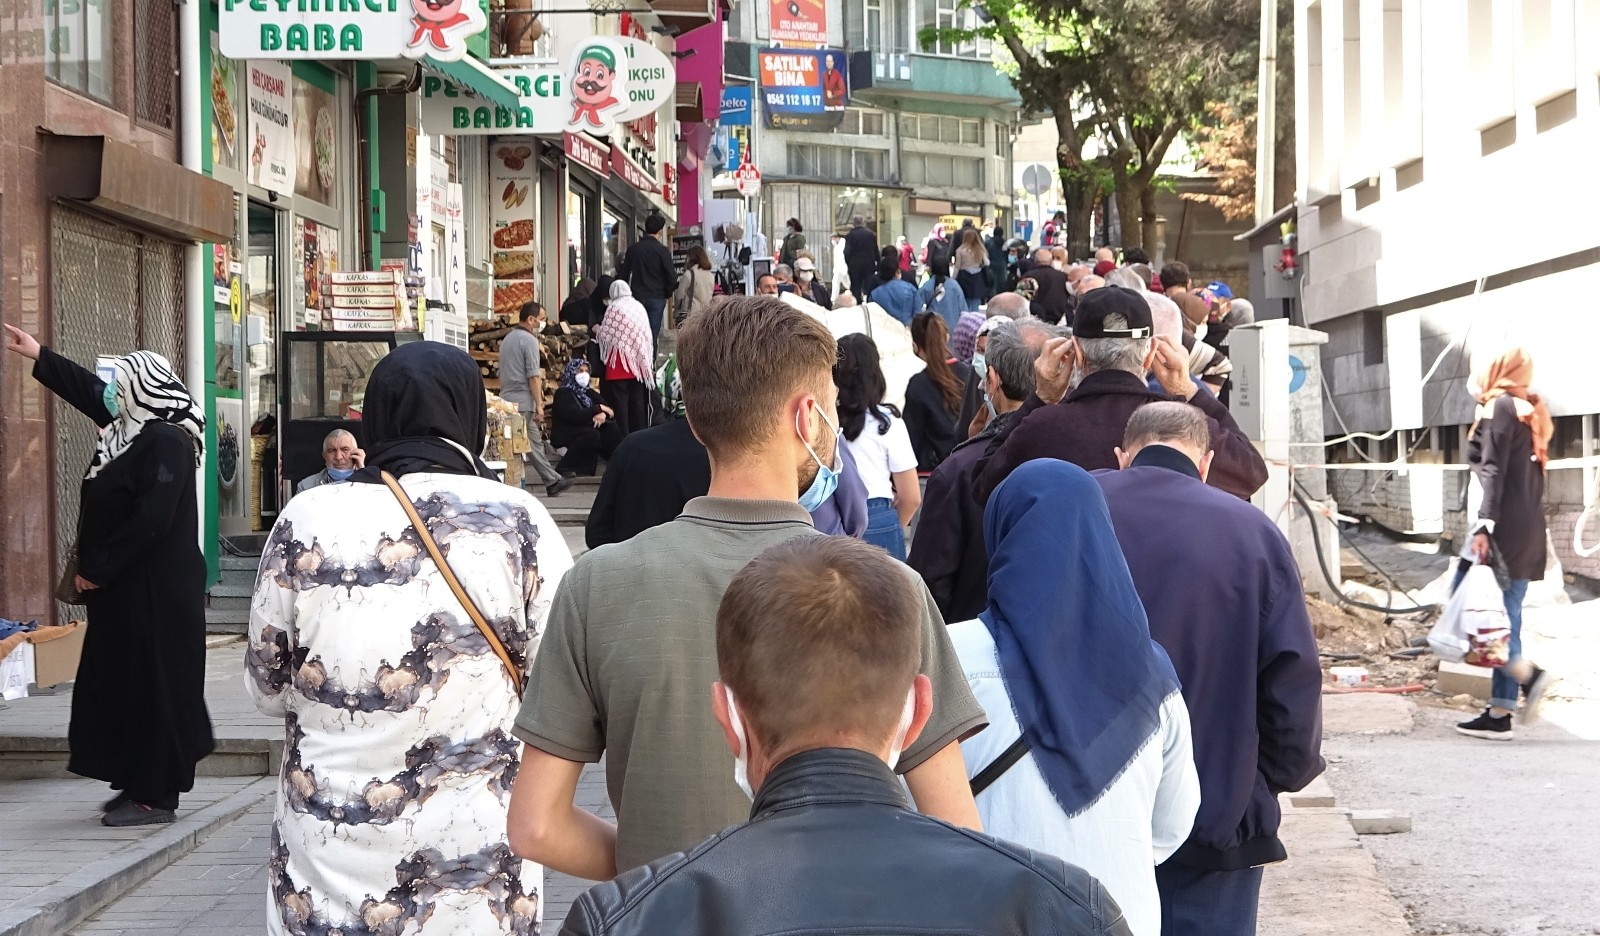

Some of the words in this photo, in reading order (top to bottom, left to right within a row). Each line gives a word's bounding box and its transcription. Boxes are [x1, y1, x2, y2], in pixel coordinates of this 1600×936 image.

[260, 23, 363, 51] BABA
[764, 55, 814, 72] SATILIK
[628, 67, 665, 83] IKÇISI
[775, 71, 805, 86] BİNA
[629, 89, 655, 102] ONU
[786, 94, 800, 105] 112
[812, 95, 821, 106] 17
[453, 106, 534, 128] BABA
[740, 167, 756, 180] DUR
[346, 273, 369, 281] KAFKAS
[346, 286, 369, 294] KAFKAS
